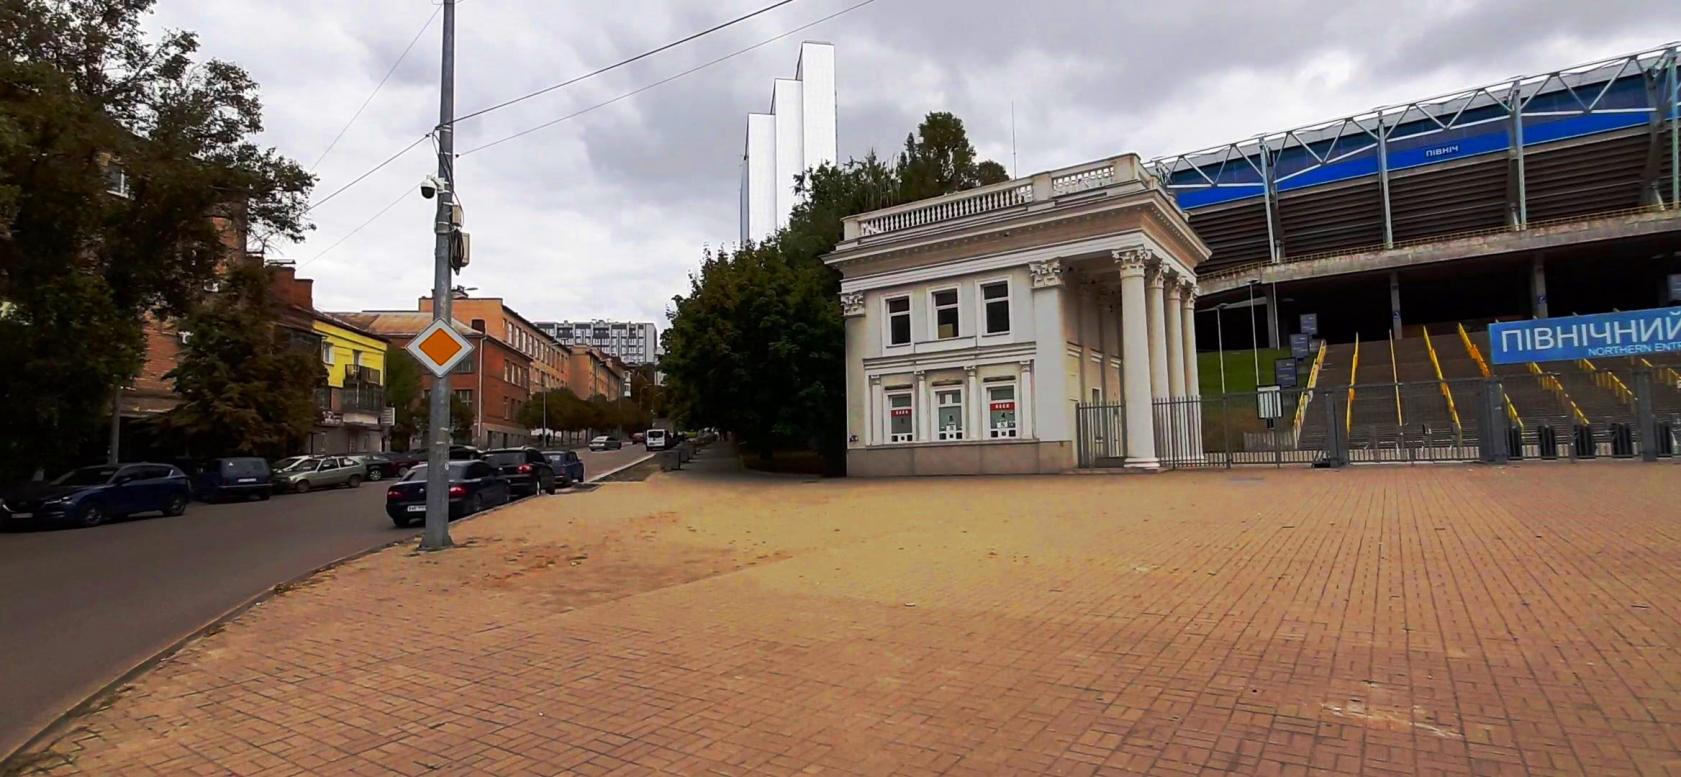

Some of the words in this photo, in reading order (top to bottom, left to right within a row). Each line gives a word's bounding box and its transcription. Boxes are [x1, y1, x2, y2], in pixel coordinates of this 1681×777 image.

[1425, 145, 1459, 157] ПІВНІЧ
[1501, 310, 1681, 352] ПІВНІЧНИЙ
[1588, 344, 1652, 356] NORTHERN
